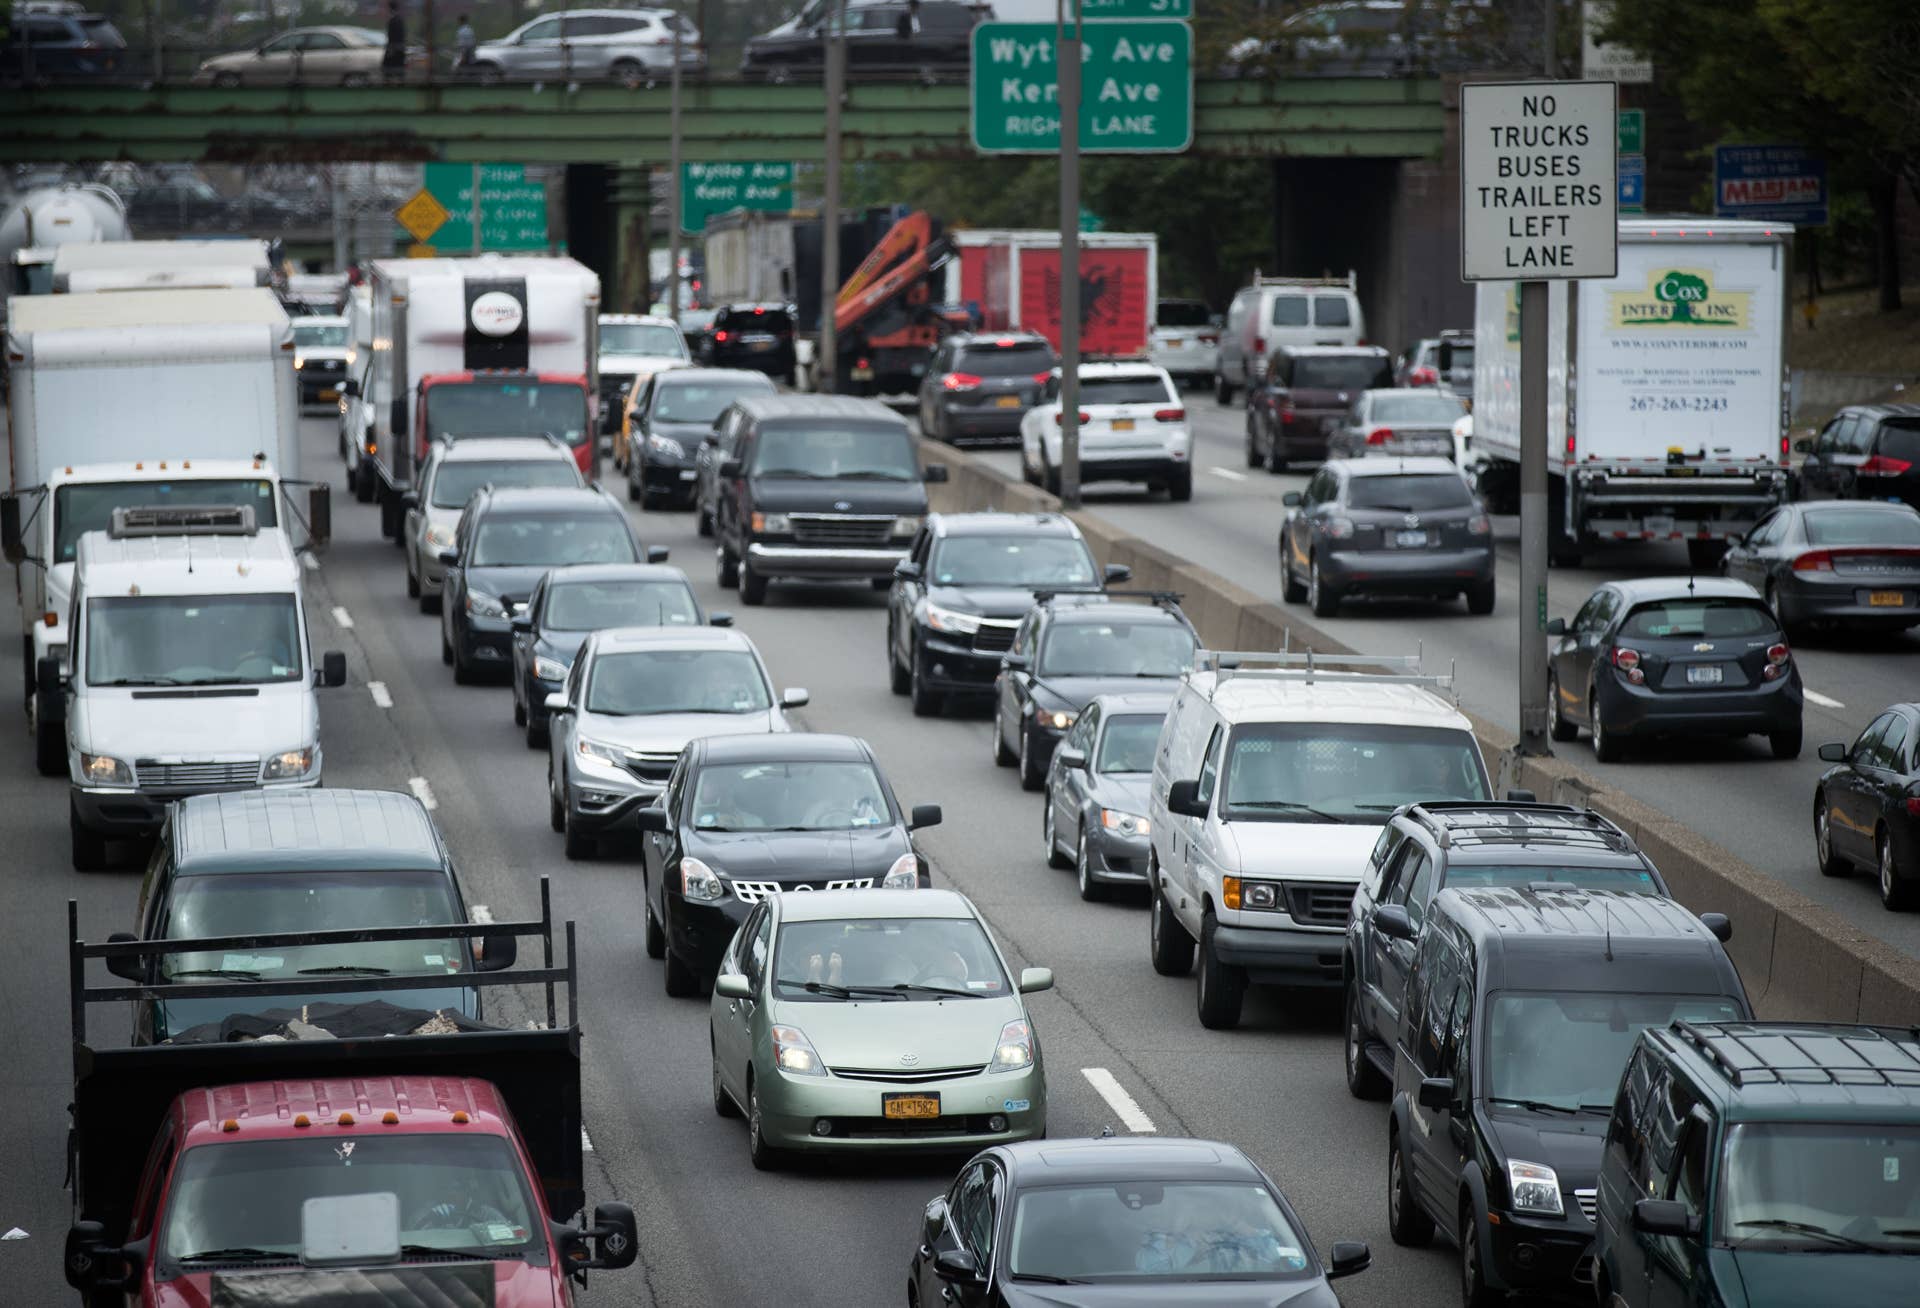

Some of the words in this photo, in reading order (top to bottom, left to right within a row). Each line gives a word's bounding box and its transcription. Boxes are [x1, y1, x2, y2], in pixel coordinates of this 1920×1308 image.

[989, 37, 1093, 69] Wyte
[1112, 37, 1175, 63] Ave
[1002, 77, 1059, 103] Ken
[1099, 77, 1161, 102] Ave
[1523, 95, 1556, 117] NO
[1005, 115, 1062, 135] RIGH
[1091, 115, 1156, 135] LANE
[1490, 125, 1589, 147] TRUCKS
[1498, 155, 1581, 177] BUSES
[1478, 185, 1602, 208] TRAILERS
[1509, 215, 1570, 237] LEFT
[1506, 245, 1574, 267] LANE
[1660, 279, 1703, 301] Cox
[1707, 304, 1739, 317] INC.
[1629, 396, 1729, 412] 267-263-2243
